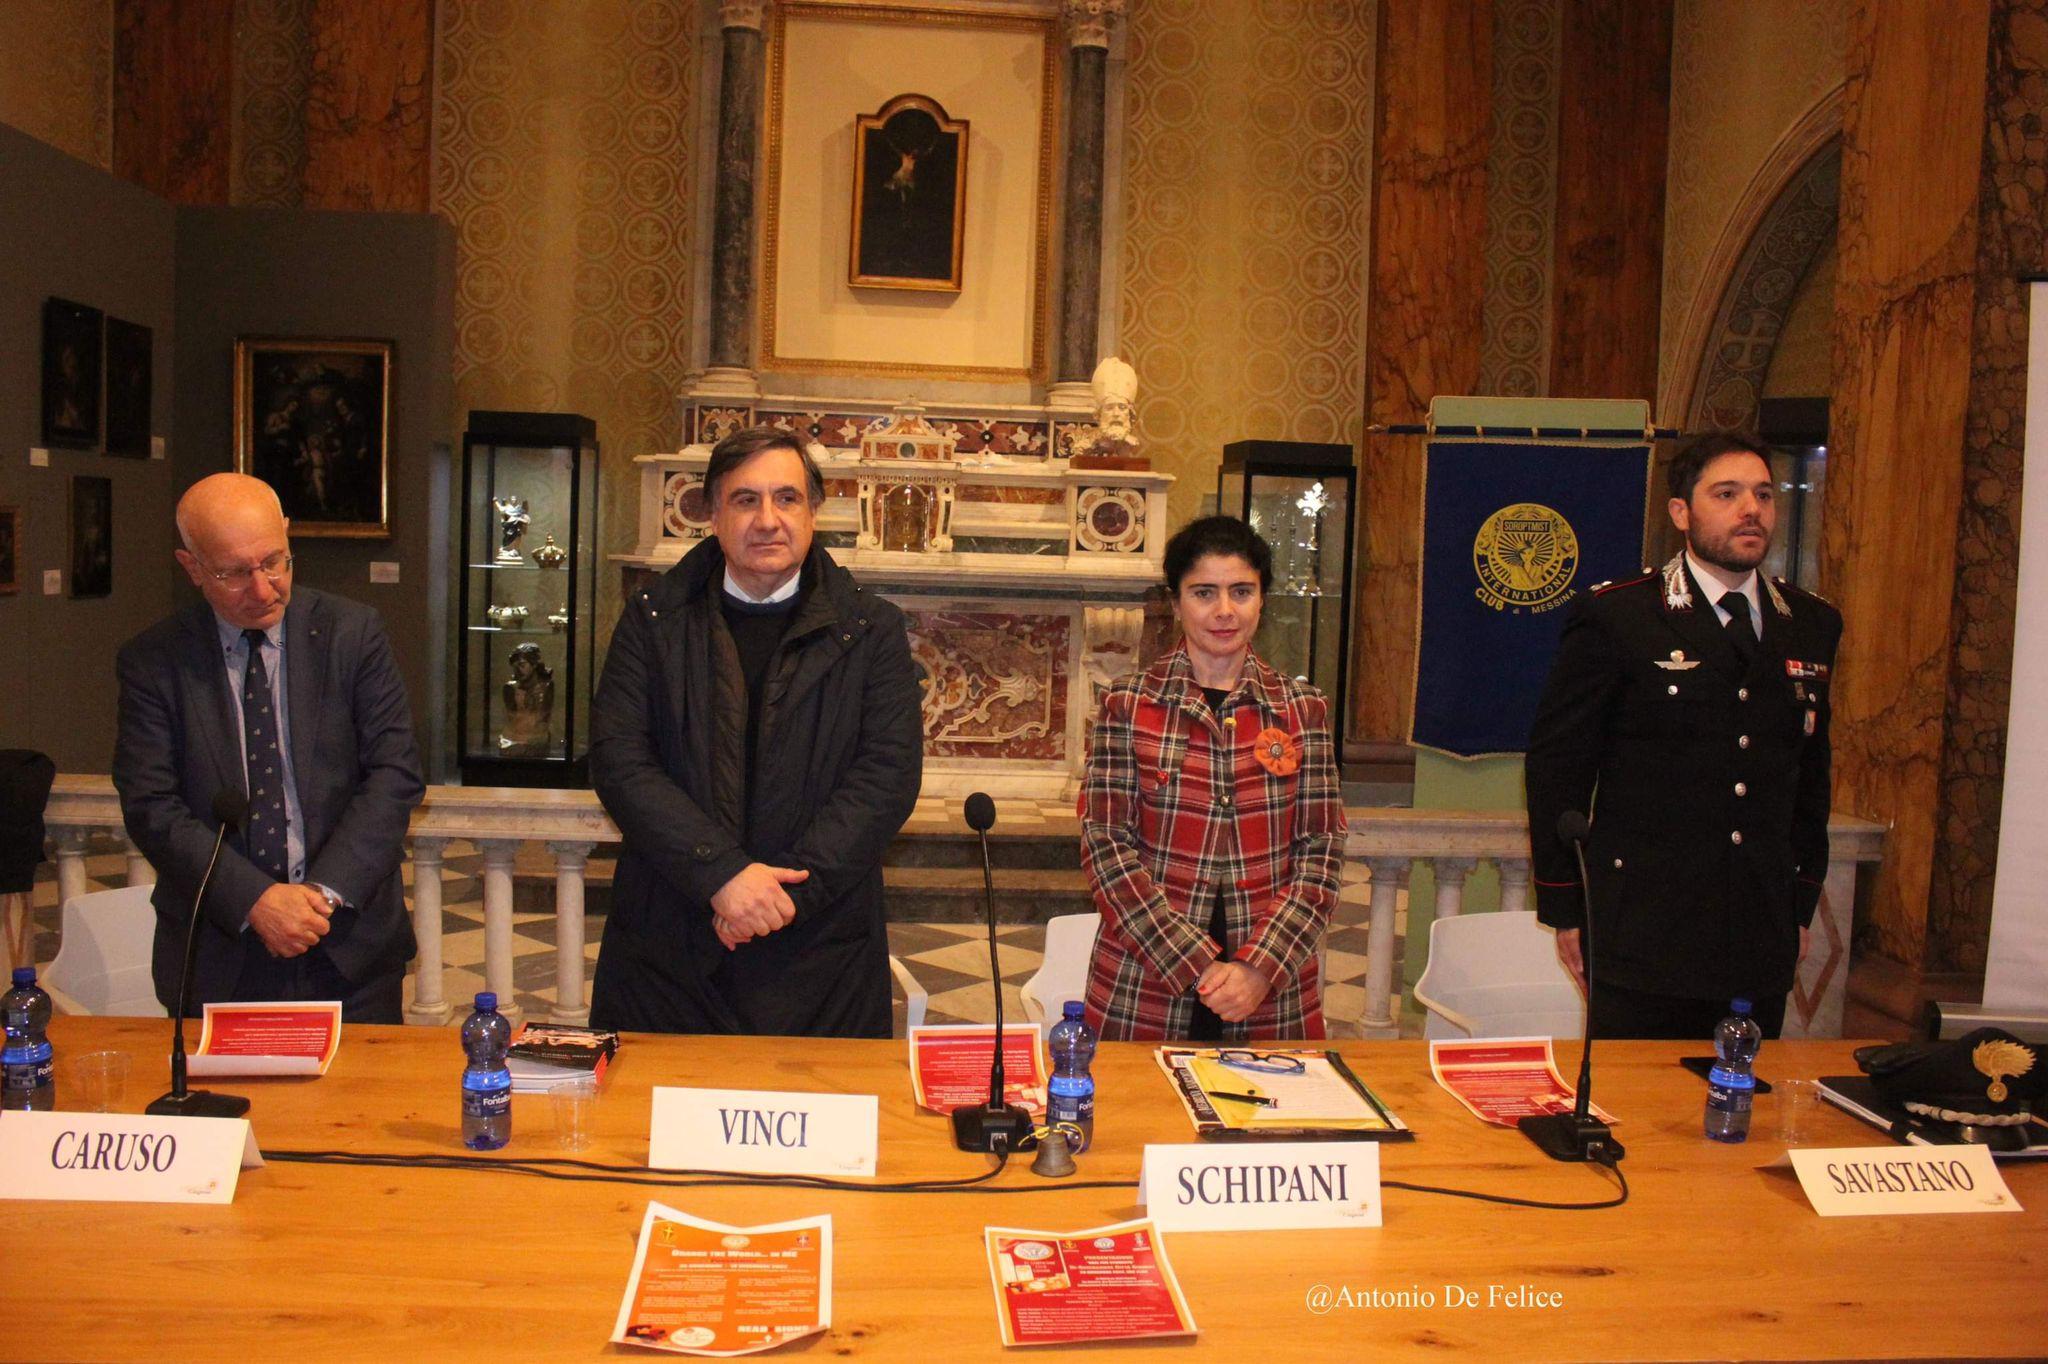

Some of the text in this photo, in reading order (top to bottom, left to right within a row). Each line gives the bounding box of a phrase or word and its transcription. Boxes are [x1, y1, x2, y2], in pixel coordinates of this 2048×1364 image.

[1475, 587, 1505, 611] CLUB
[1531, 588, 1577, 614] MESSINA
[1480, 564, 1572, 601] INTERNATIONAL
[719, 1109, 807, 1148] VINCI
[51, 1131, 176, 1172] CARUSO
[1178, 1164, 1349, 1205] SCHIPANI
[1827, 1160, 1975, 1194] SAVASTANO
